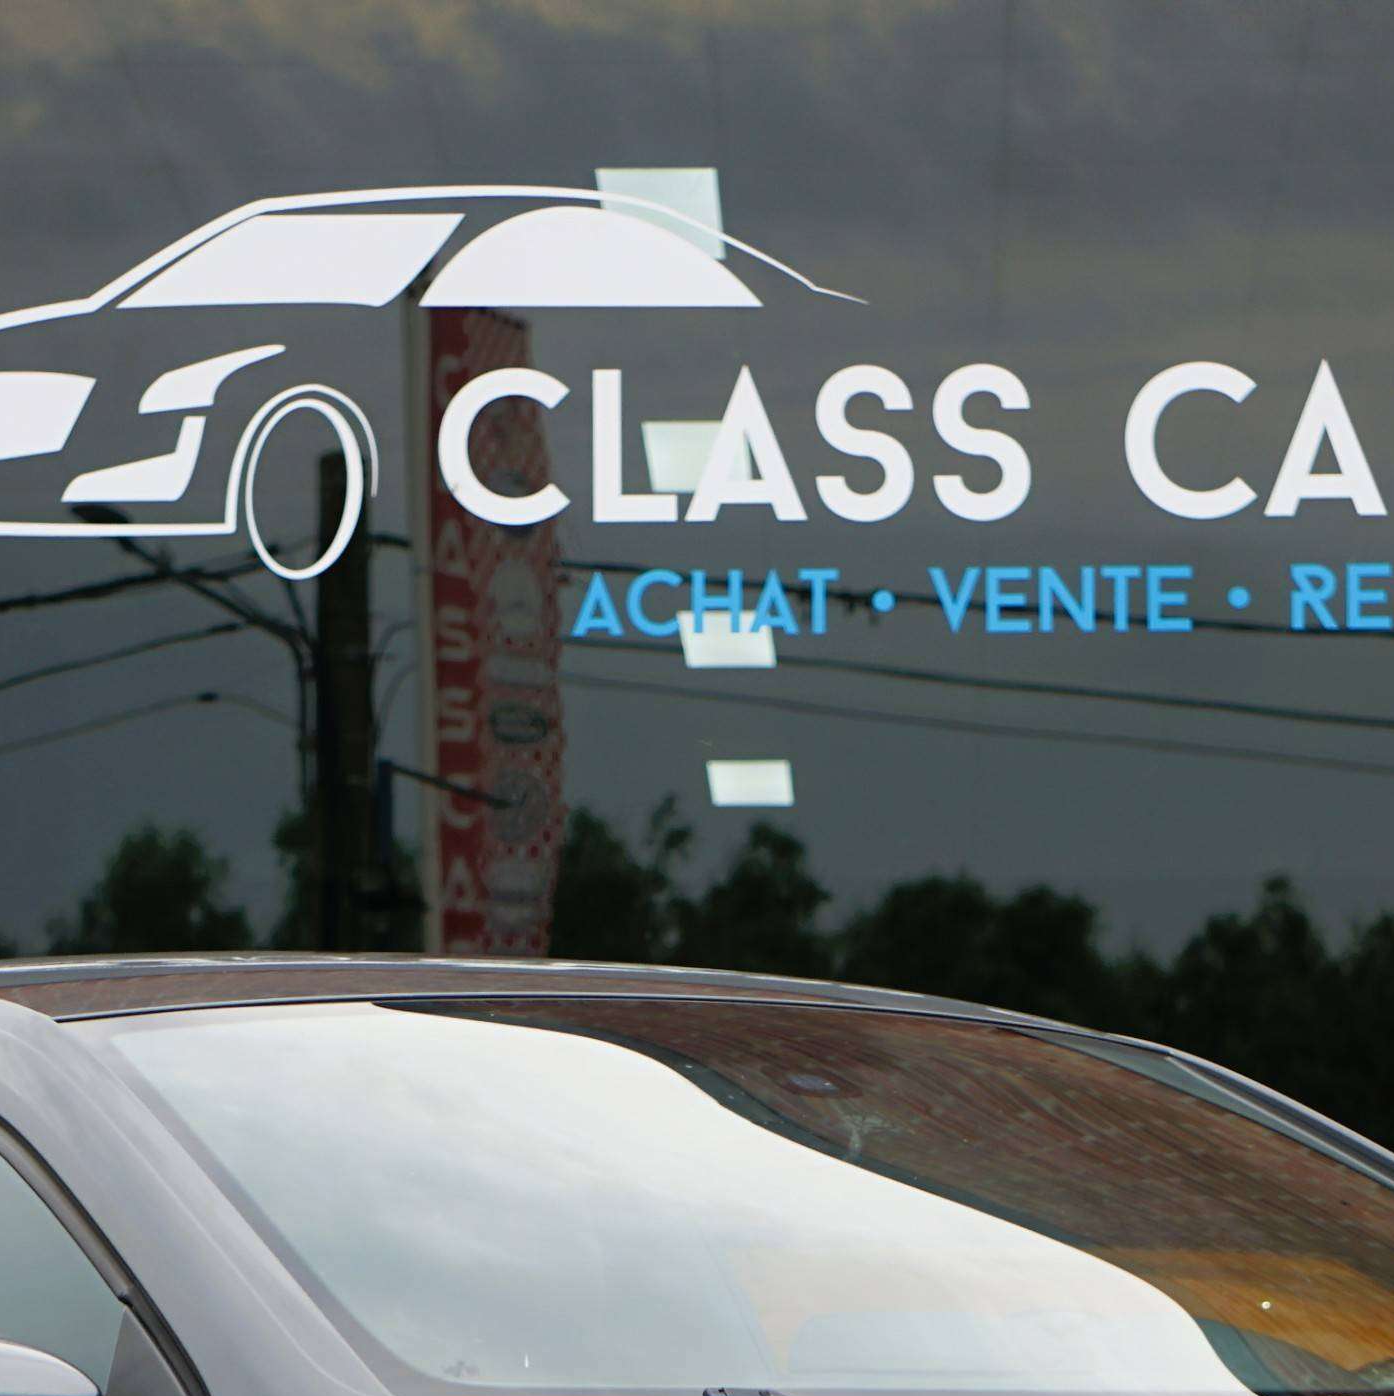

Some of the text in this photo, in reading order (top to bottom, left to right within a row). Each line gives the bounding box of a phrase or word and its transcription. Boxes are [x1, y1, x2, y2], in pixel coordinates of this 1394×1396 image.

[438, 363, 1031, 525] CLASS
[571, 568, 840, 638] ACHAT
[928, 565, 1193, 634] VENTE
